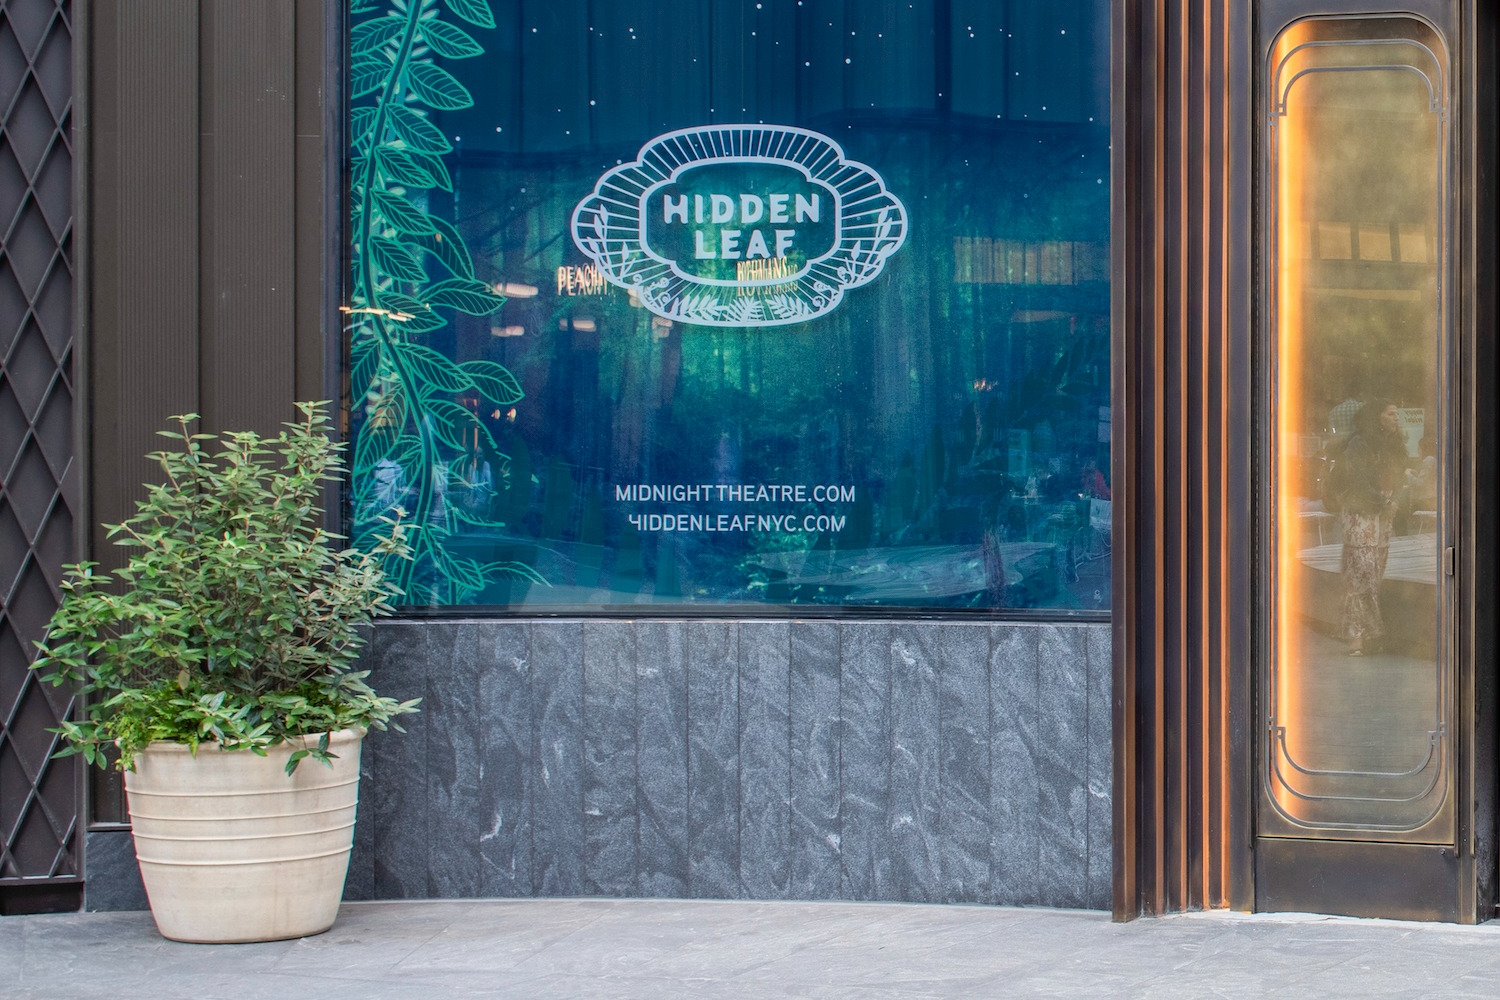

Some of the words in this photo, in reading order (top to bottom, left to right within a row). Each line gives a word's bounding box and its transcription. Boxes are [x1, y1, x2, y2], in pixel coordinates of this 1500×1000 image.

[664, 193, 820, 225] HIDDEN
[695, 229, 796, 260] LEAF
[615, 484, 856, 502] MIDNIGHTTHEATRE.COM
[628, 514, 846, 532] HIDDENLEAFNYC.COM
